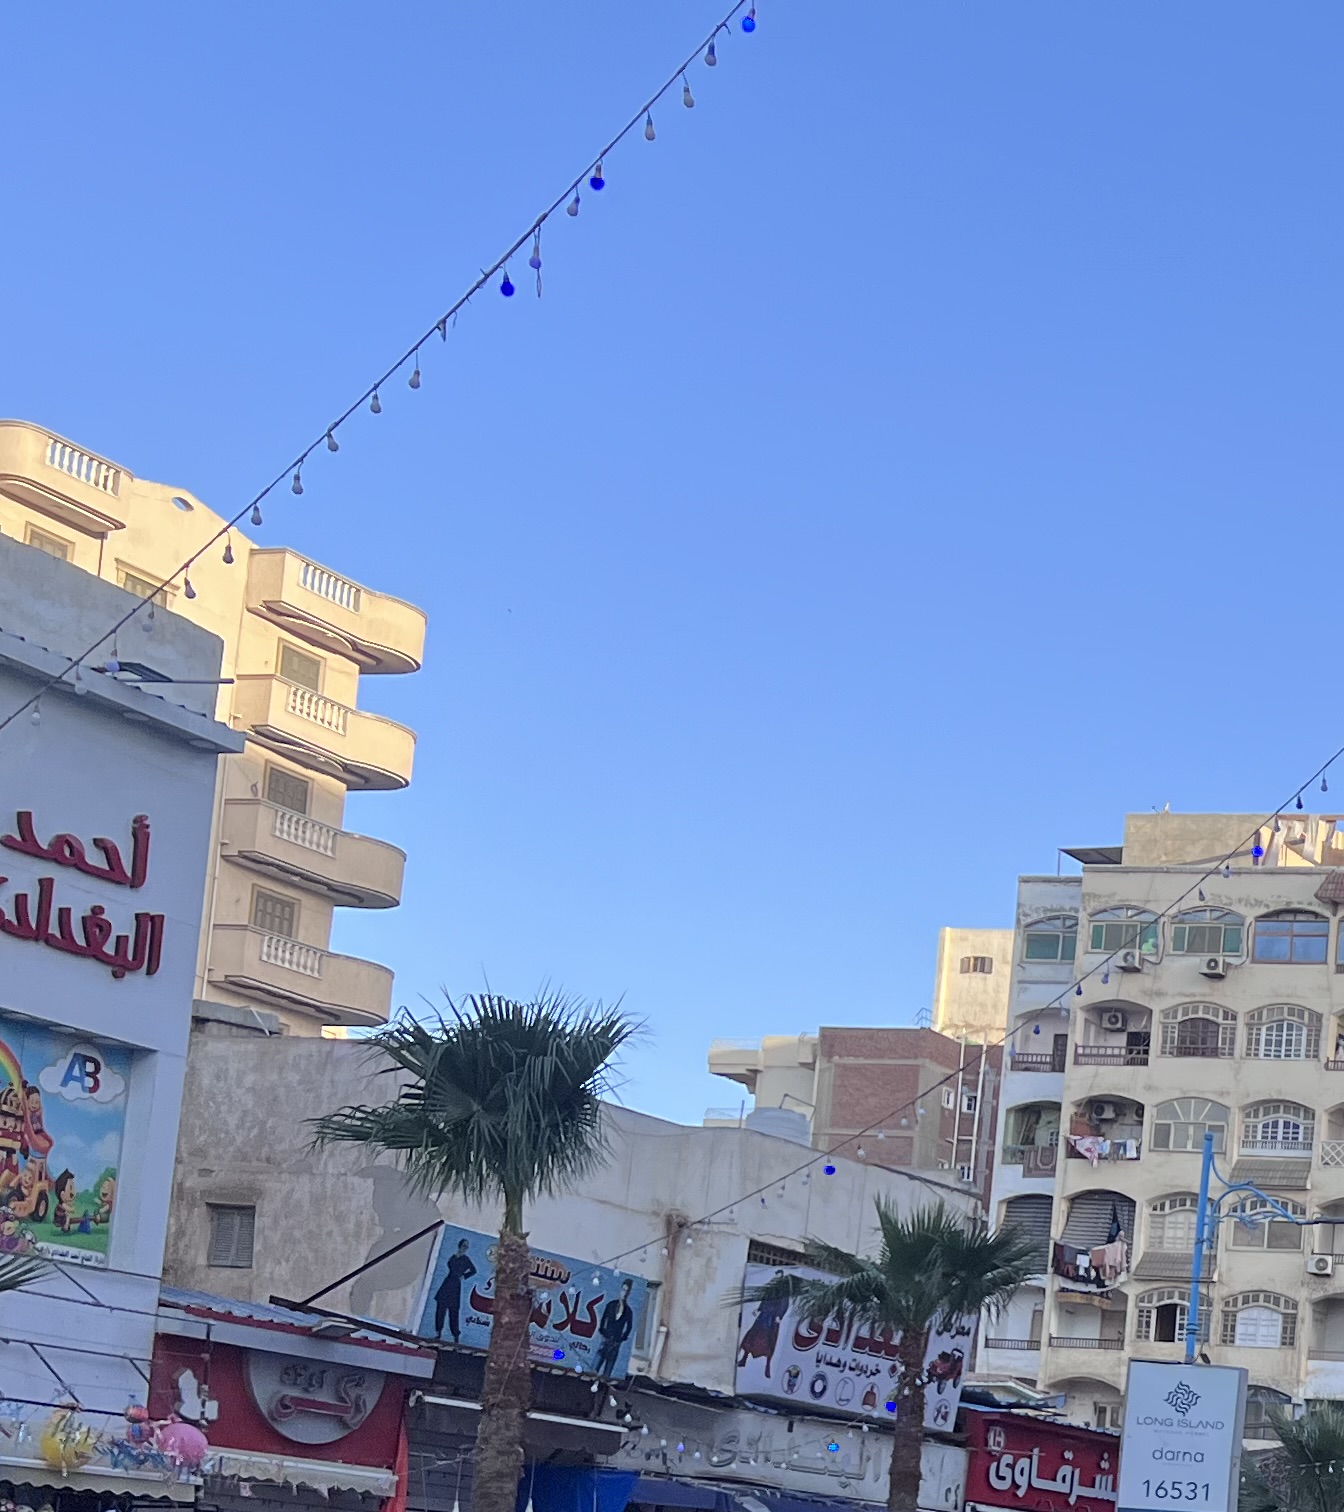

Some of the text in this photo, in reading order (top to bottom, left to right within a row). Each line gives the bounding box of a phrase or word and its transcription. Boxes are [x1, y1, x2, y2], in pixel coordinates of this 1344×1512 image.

[0, 811, 150, 888] أحمد
[0, 876, 165, 979] البغداد
[60, 1052, 102, 1094] AB
[1136, 1416, 1225, 1430] LONG ISLAND
[1152, 1447, 1204, 1463] darna
[989, 1447, 1119, 1506] شرقاوى
[1142, 1479, 1210, 1502] 16531
